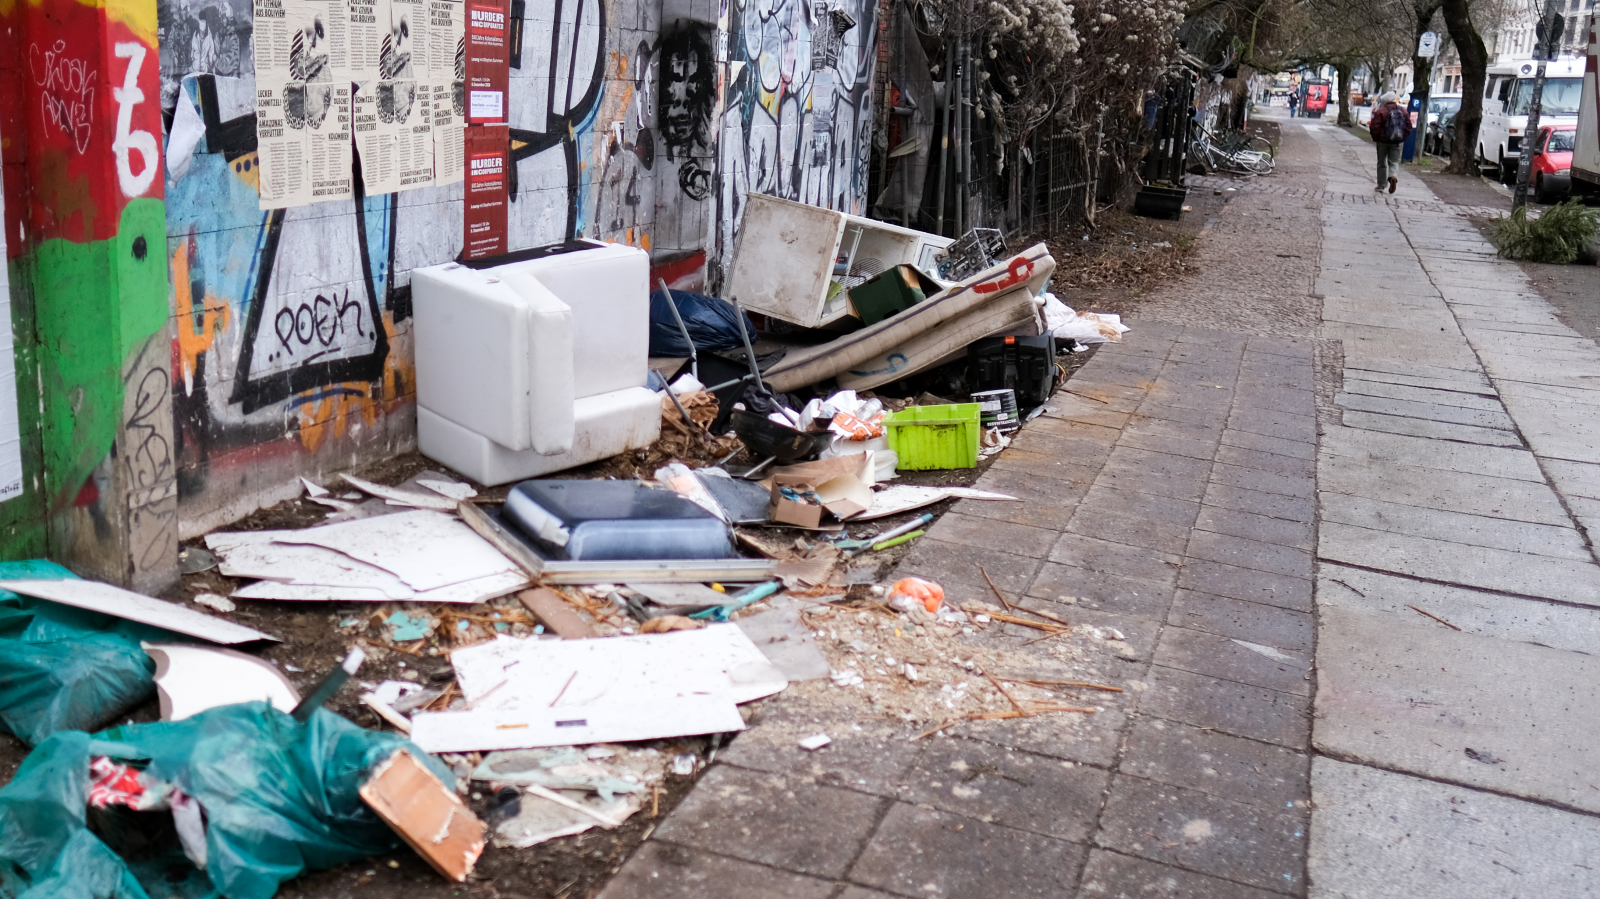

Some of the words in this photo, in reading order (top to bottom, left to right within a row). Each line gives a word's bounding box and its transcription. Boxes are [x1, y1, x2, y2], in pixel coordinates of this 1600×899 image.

[471, 10, 504, 23] MURDER
[471, 20, 504, 29] INCORPORATED
[258, 99, 281, 107] SCHNITZEL!
[259, 119, 283, 128] AMAZONAS
[471, 158, 502, 169] MURDER
[471, 167, 502, 176] INCORPORATED
